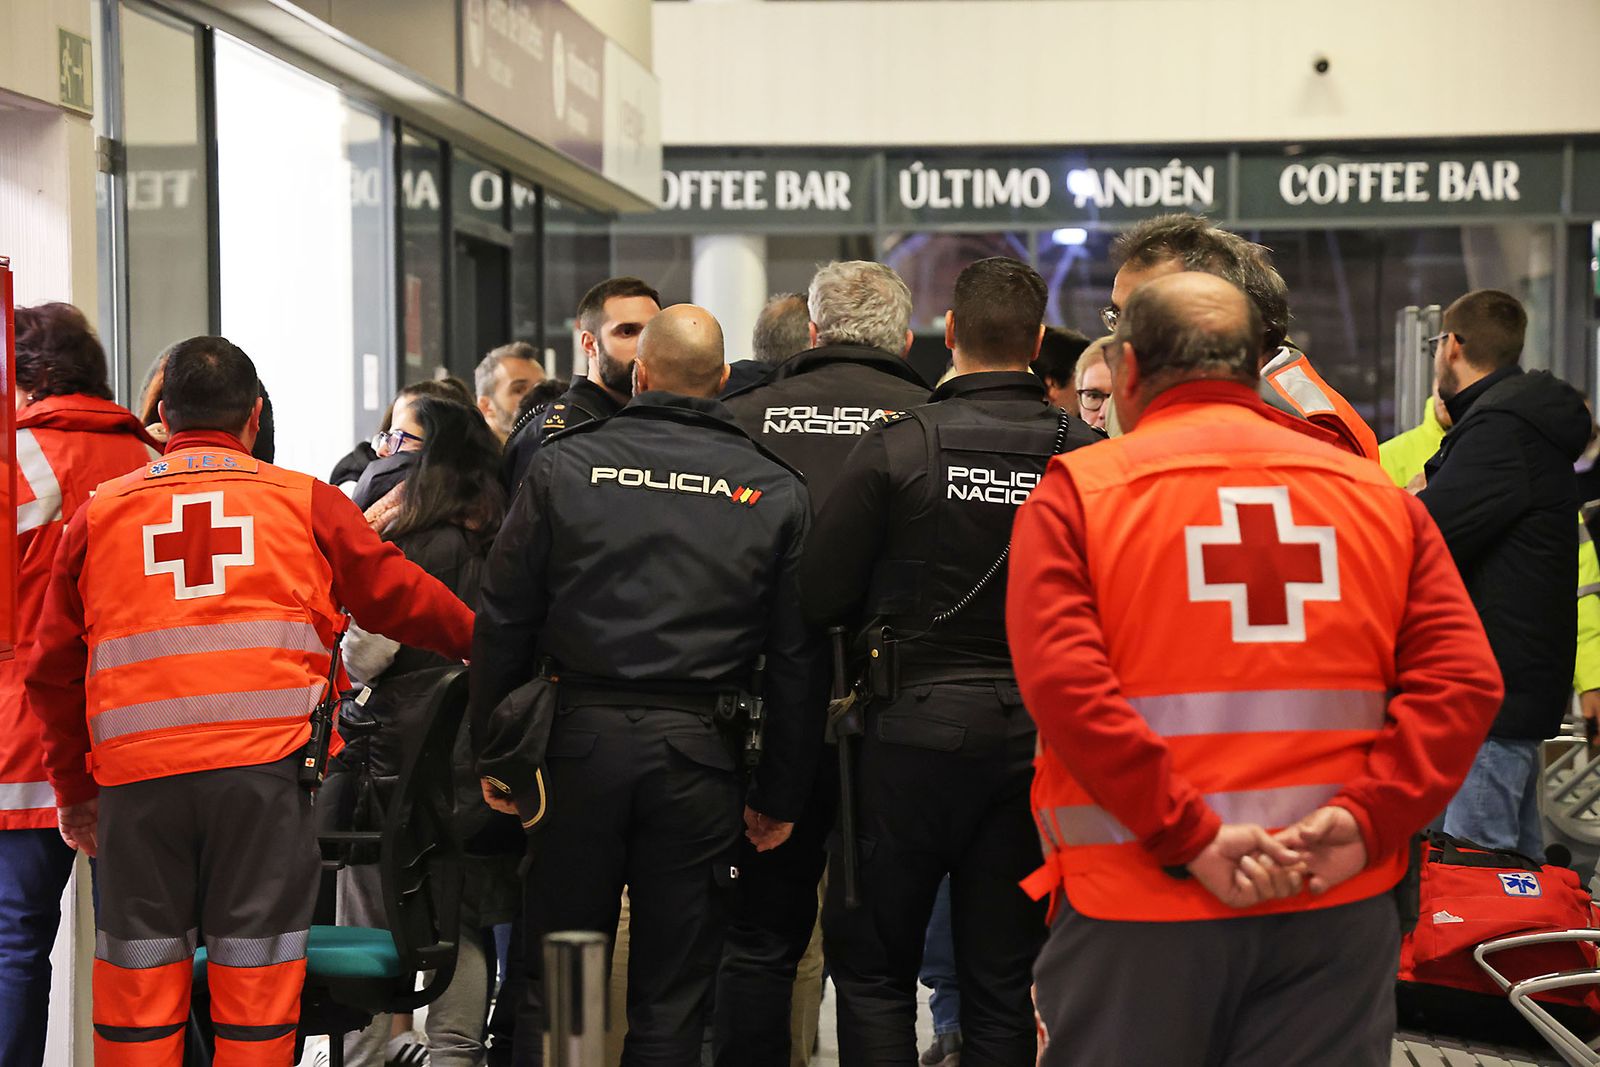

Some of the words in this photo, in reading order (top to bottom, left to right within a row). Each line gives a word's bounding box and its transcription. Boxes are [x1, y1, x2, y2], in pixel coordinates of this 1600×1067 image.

[662, 170, 768, 210] OFFEE
[775, 170, 851, 210] BAR
[899, 161, 1051, 208] ÚLTIMO
[1279, 162, 1430, 205] COFFEE
[1438, 160, 1521, 201] BAR
[762, 419, 871, 435] NACION
[764, 406, 888, 423] POLICIA
[590, 467, 733, 498] POLICIA
[947, 465, 1042, 489] POLICI
[946, 483, 1032, 506] NACIO
